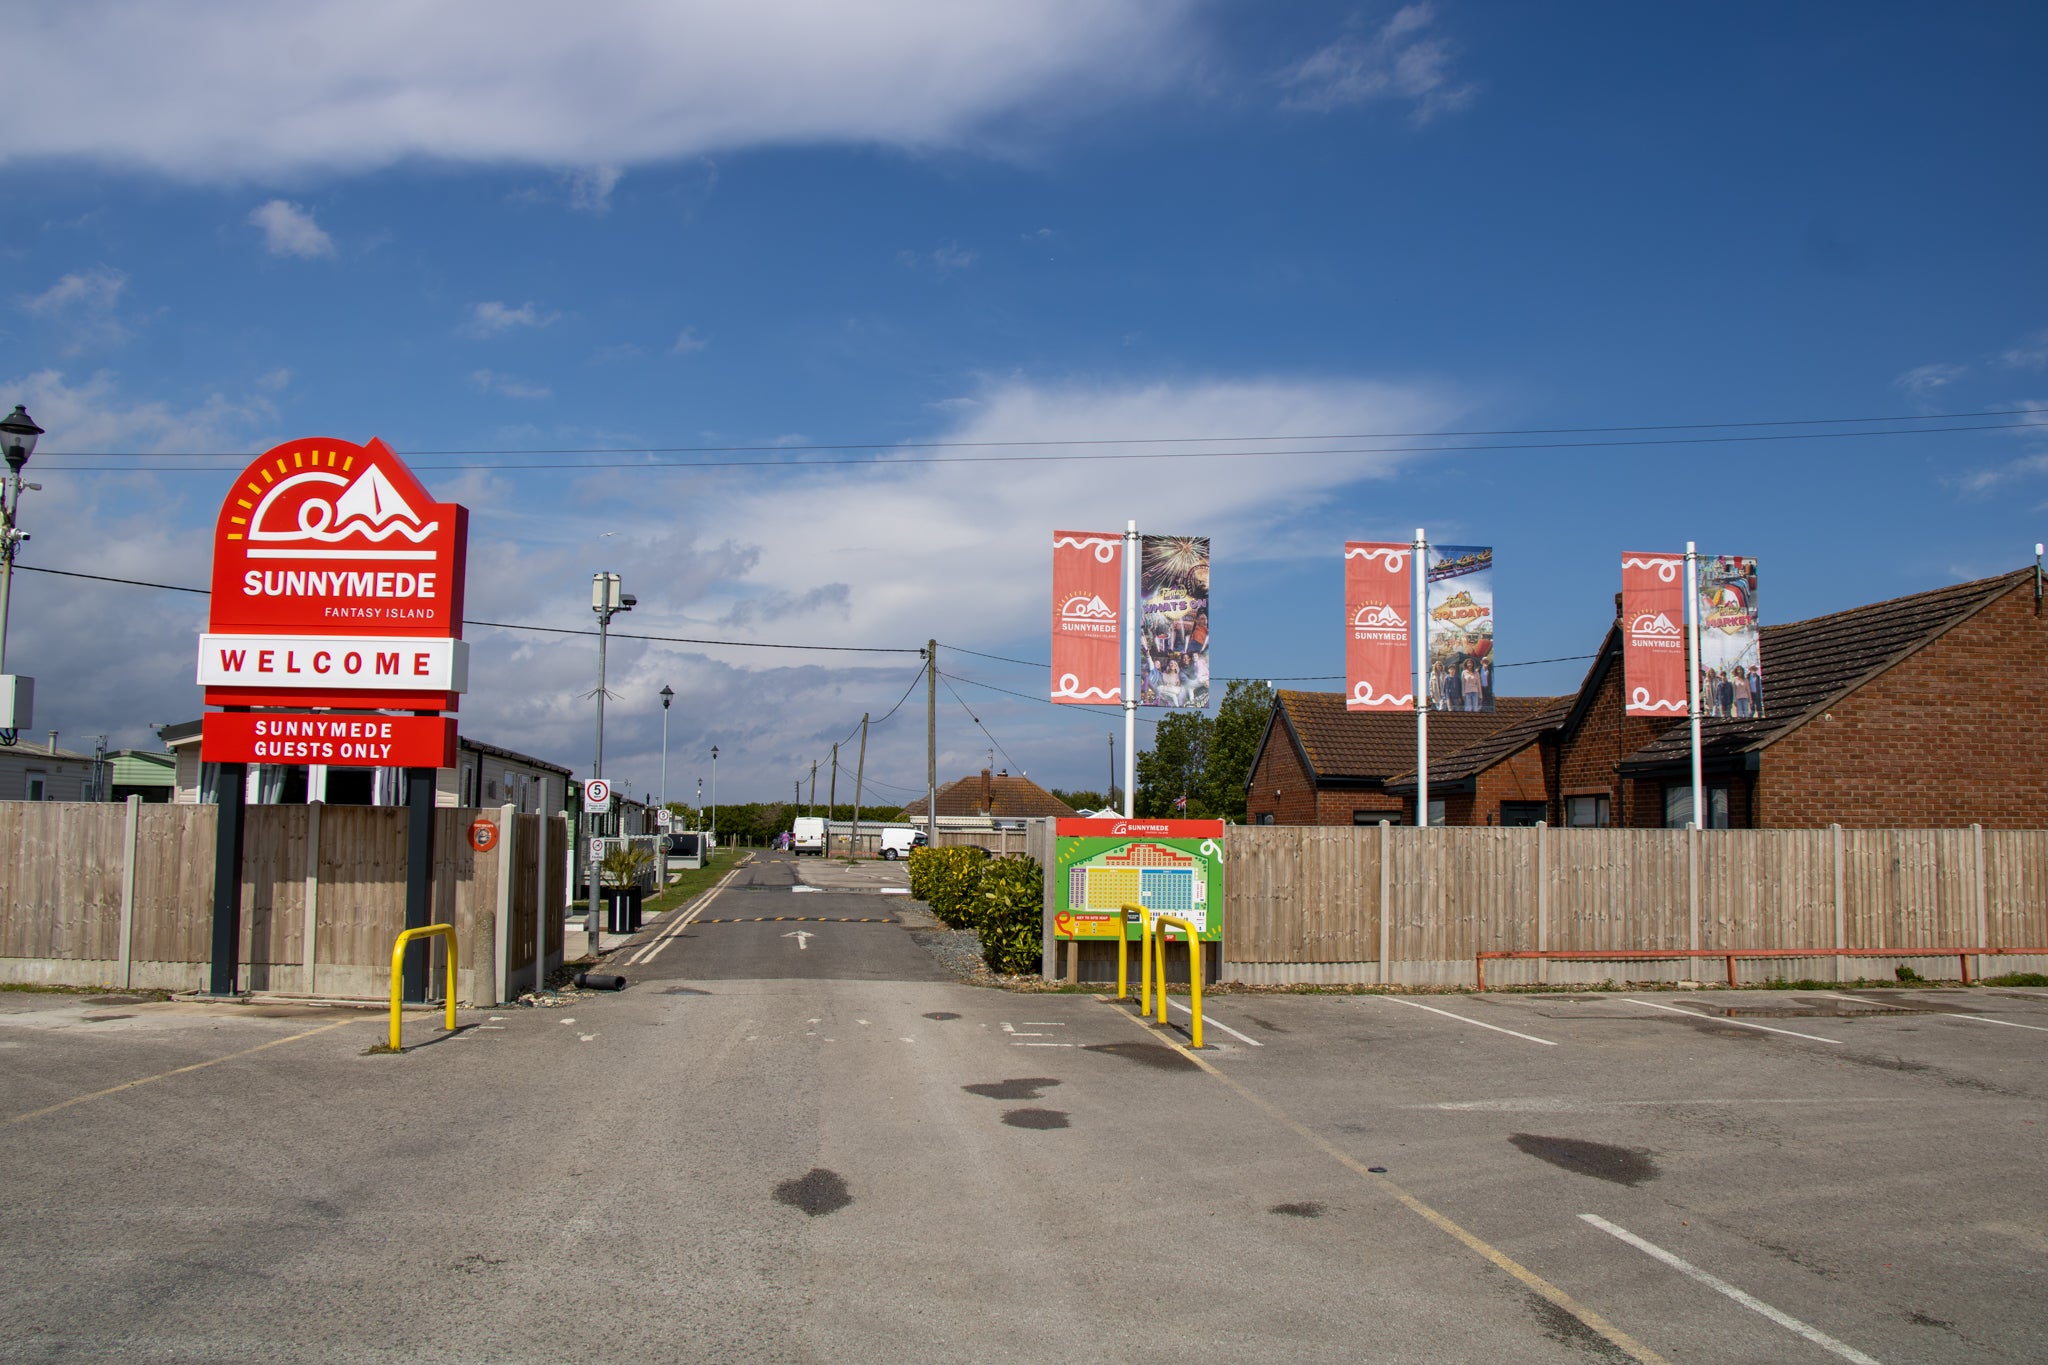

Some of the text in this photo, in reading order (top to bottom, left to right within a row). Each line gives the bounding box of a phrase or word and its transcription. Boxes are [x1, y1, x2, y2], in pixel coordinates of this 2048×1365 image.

[243, 570, 436, 598] SUNNYMEDE
[1190, 599, 1207, 609] ON
[324, 607, 435, 619] FANTASY ISLAND
[1432, 607, 1490, 621] HOLIDAYS
[1705, 615, 1753, 628] MARKET
[1062, 623, 1117, 633] SUNNYMEDE
[1354, 632, 1407, 640] SUNNYMEDE
[1632, 639, 1681, 648] SUNNYMEDE
[220, 649, 431, 676] WELCOME
[255, 720, 392, 738] SUNNYMEDE
[254, 741, 392, 759] GUESTS ONLY
[593, 785, 602, 795] 5
